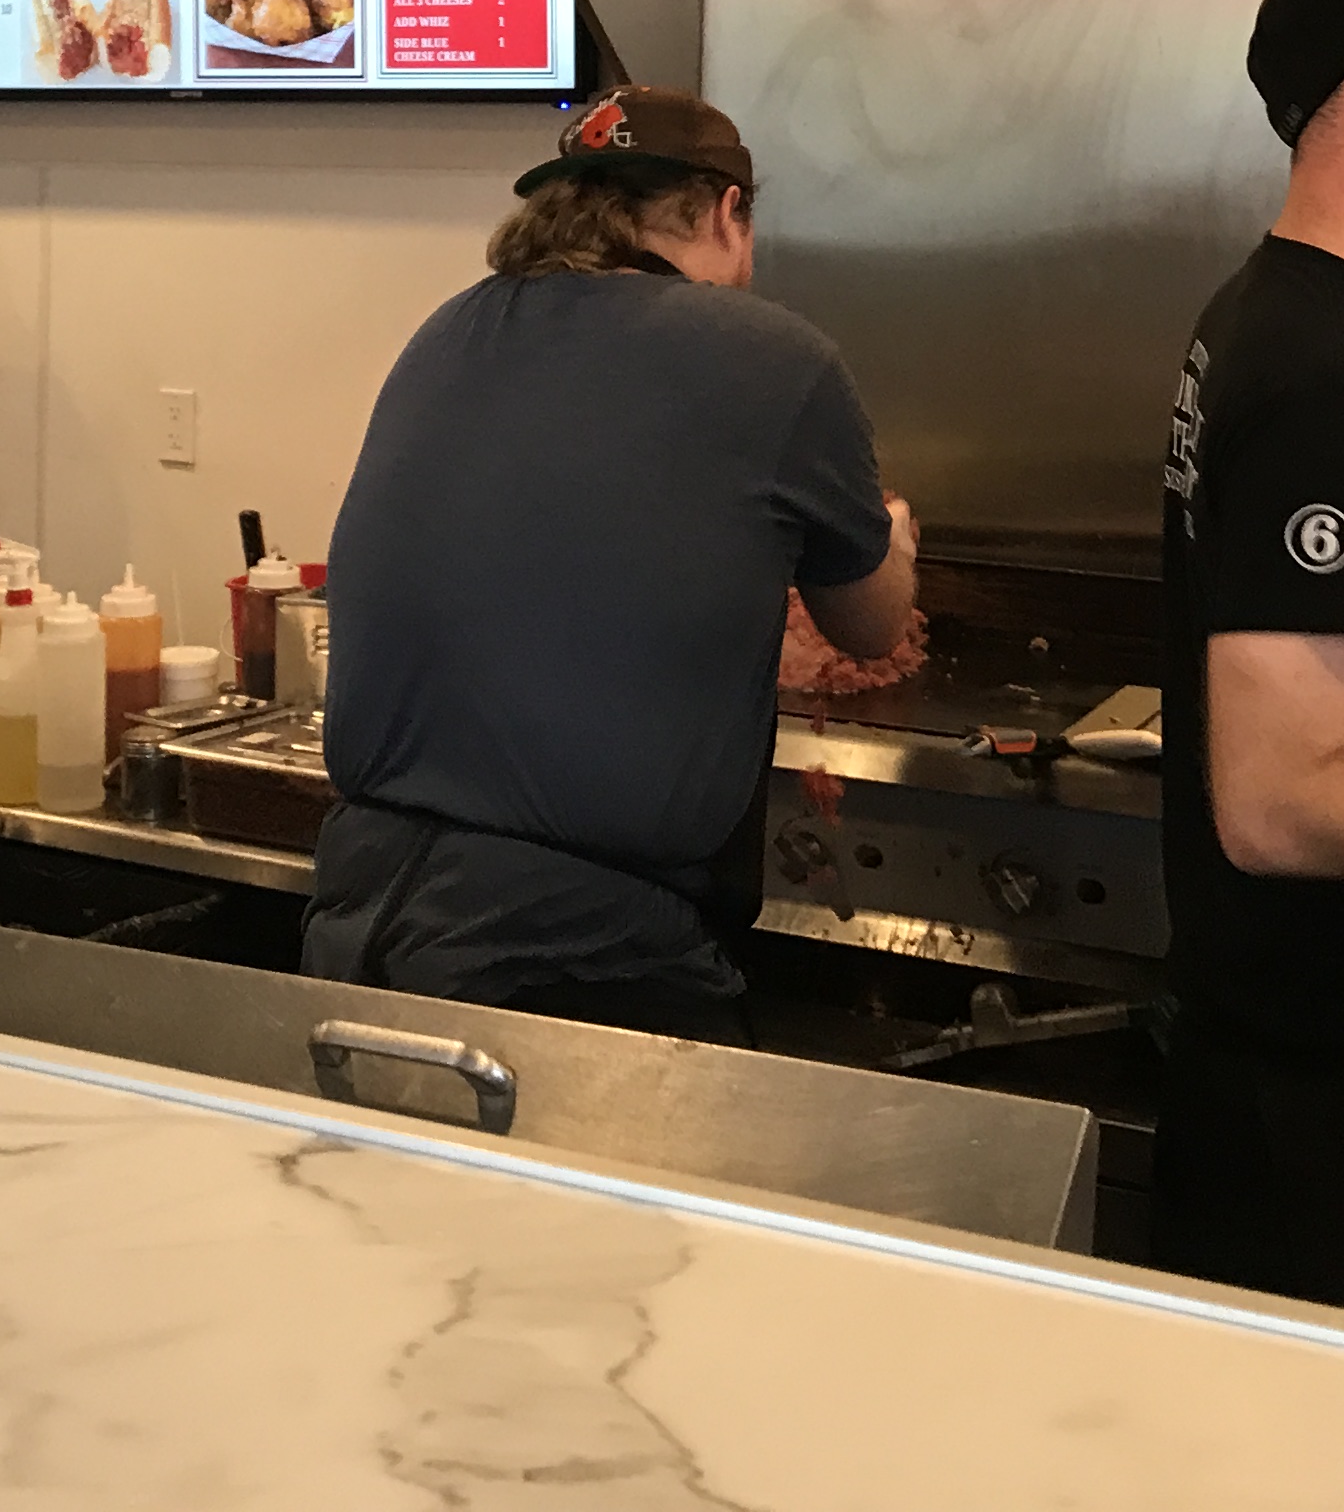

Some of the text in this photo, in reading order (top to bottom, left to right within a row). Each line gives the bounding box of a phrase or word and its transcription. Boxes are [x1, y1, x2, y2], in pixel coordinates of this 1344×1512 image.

[393, 16, 505, 27] ADD WHIZ 1
[393, 37, 505, 48] SIDE BLUE 1
[393, 51, 476, 62] CHEESE CREAM
[1301, 514, 1341, 564] 6
